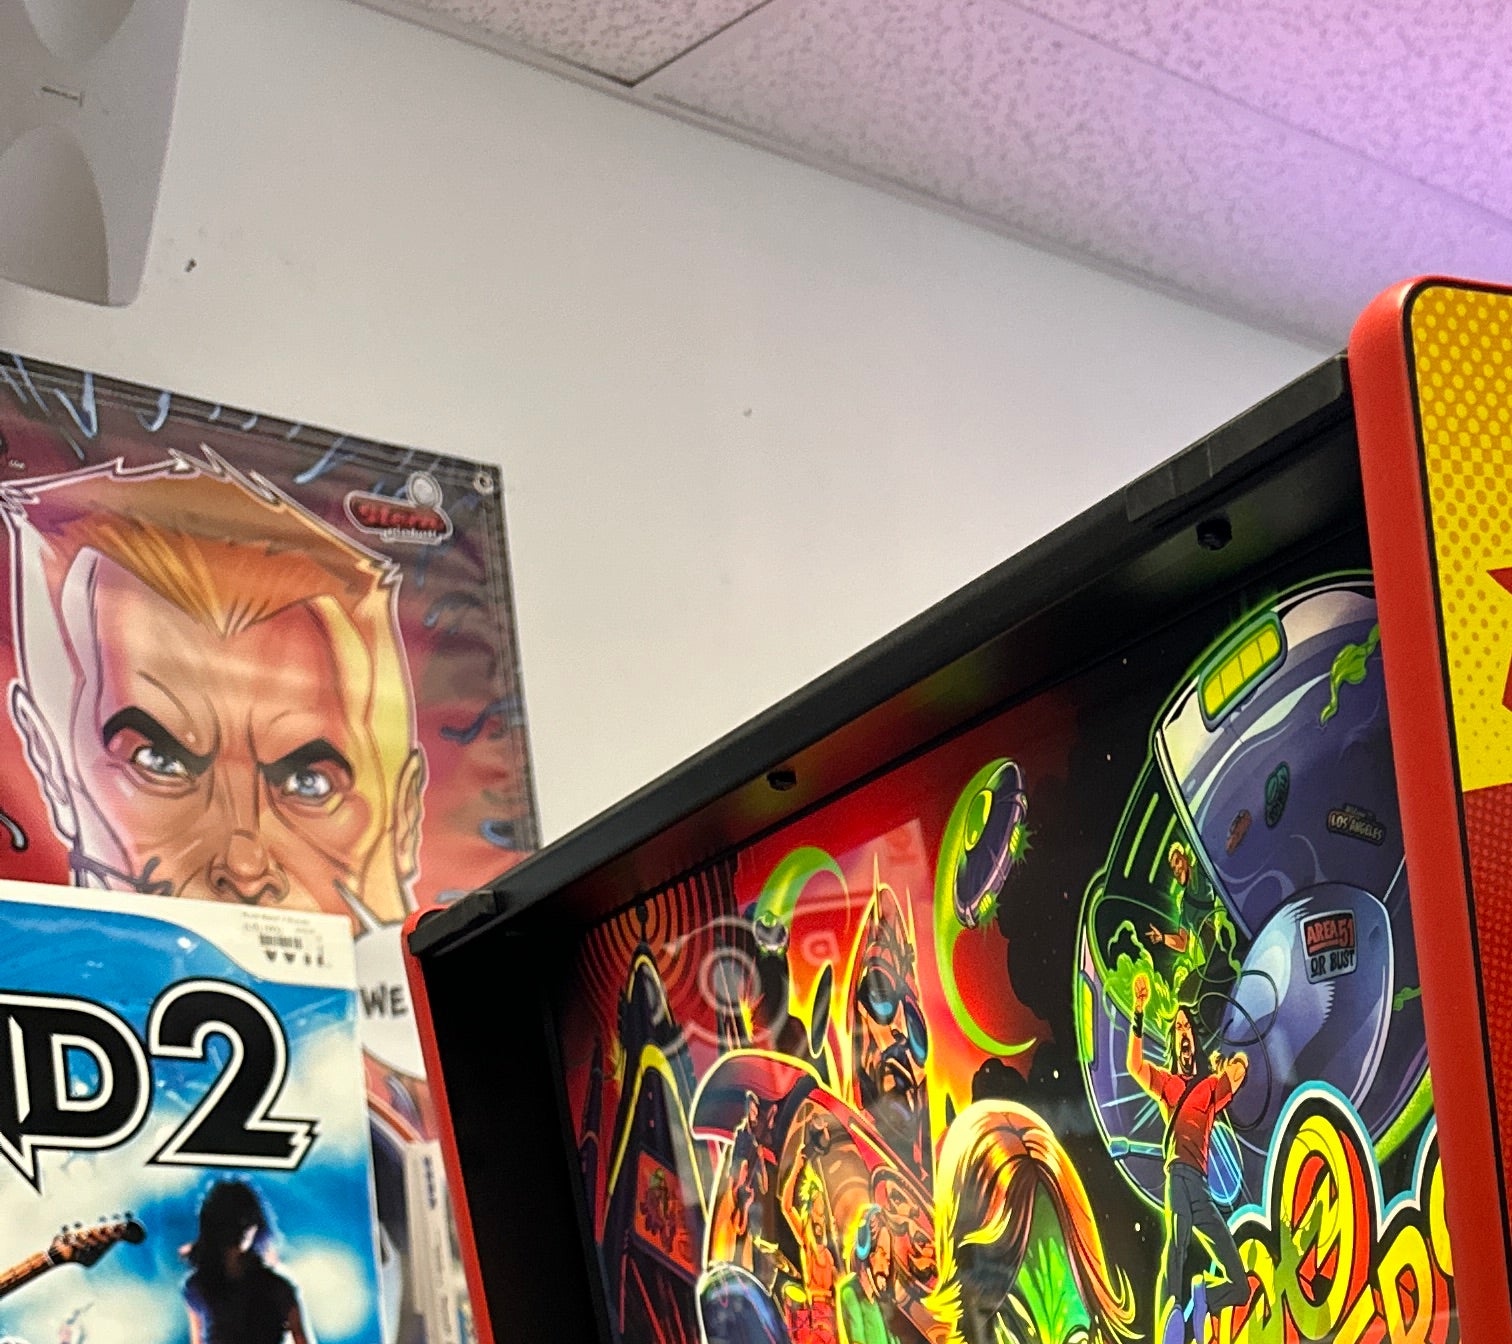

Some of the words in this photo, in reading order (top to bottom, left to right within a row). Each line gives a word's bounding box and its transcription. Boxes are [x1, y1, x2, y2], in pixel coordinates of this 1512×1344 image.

[1331, 813, 1349, 830] LOS
[1350, 819, 1384, 841] ANGELES
[1306, 919, 1338, 946] AREA
[1339, 917, 1355, 949] 51
[1310, 956, 1327, 978] OR
[1330, 950, 1355, 973] BUST
